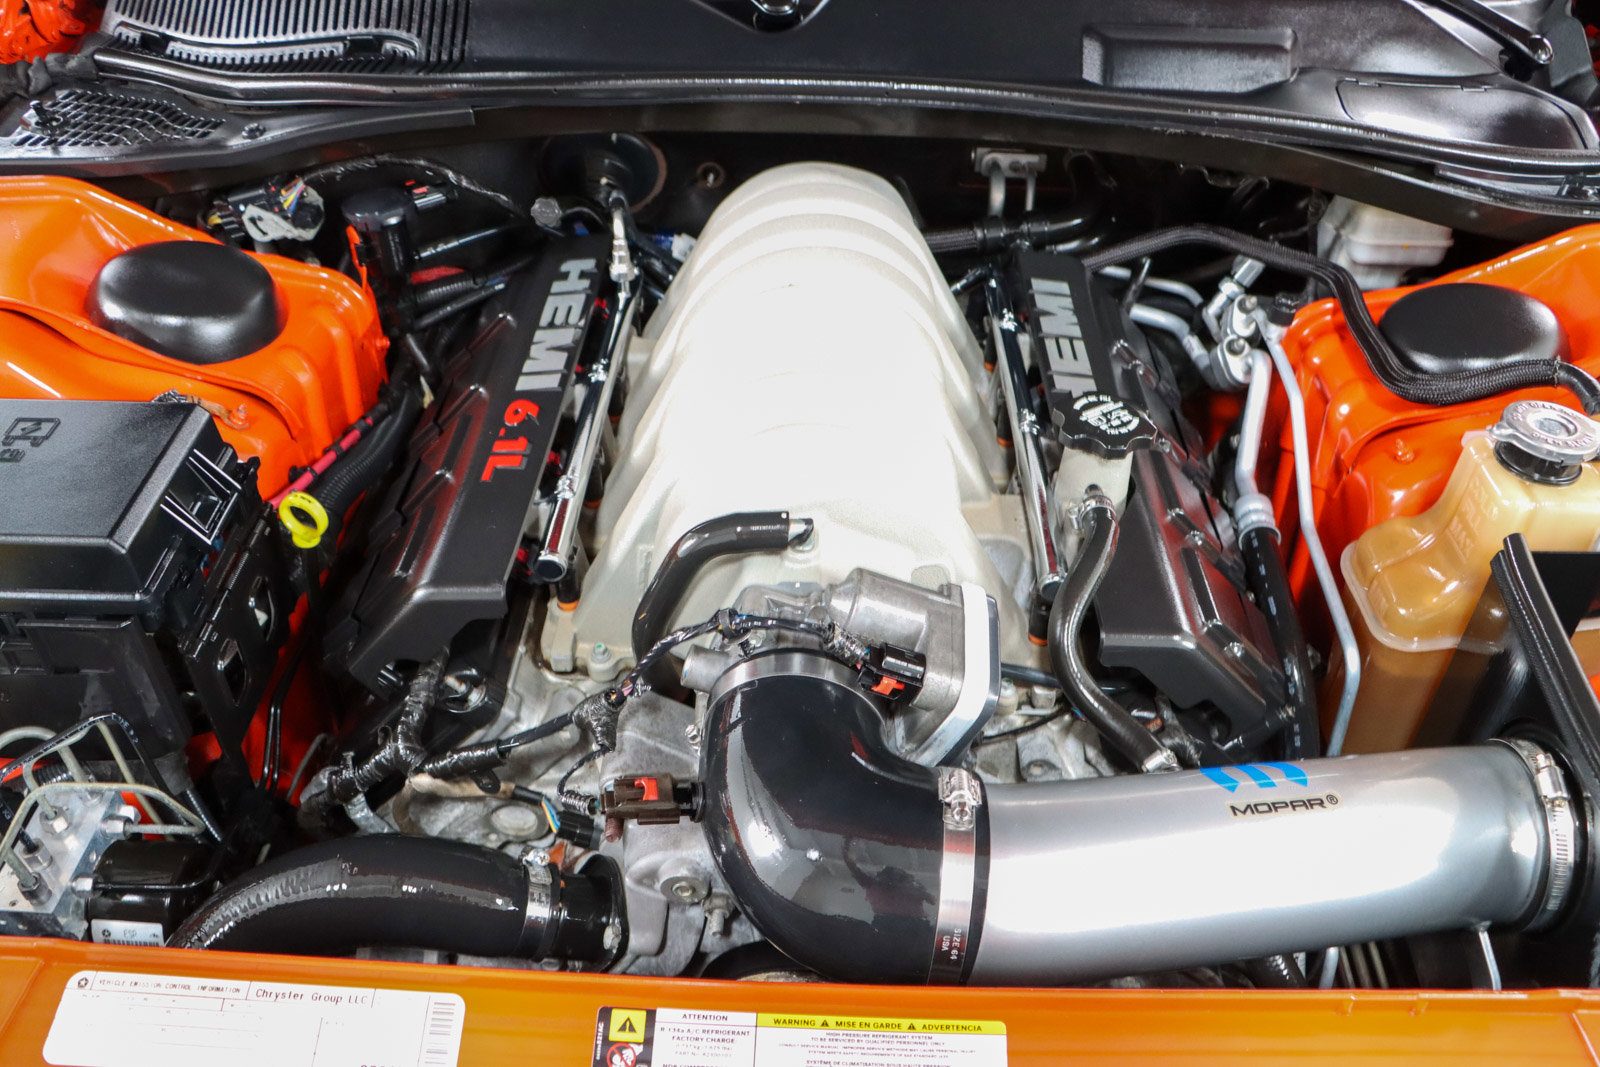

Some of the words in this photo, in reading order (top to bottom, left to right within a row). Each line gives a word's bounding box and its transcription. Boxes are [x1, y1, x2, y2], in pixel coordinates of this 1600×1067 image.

[515, 258, 597, 391] HEMI
[481, 399, 541, 482] 6.1L
[941, 935, 951, 951] USA
[952, 927, 962, 948] SIZE
[256, 988, 304, 1002] Chrysler
[311, 992, 342, 1005] Group
[348, 995, 368, 1004] LLC
[682, 1013, 728, 1021] ATTENTION
[773, 1018, 816, 1027] WARNING
[873, 1022, 902, 1030] GARDE
[921, 1024, 983, 1032] ADVERTENCIA
